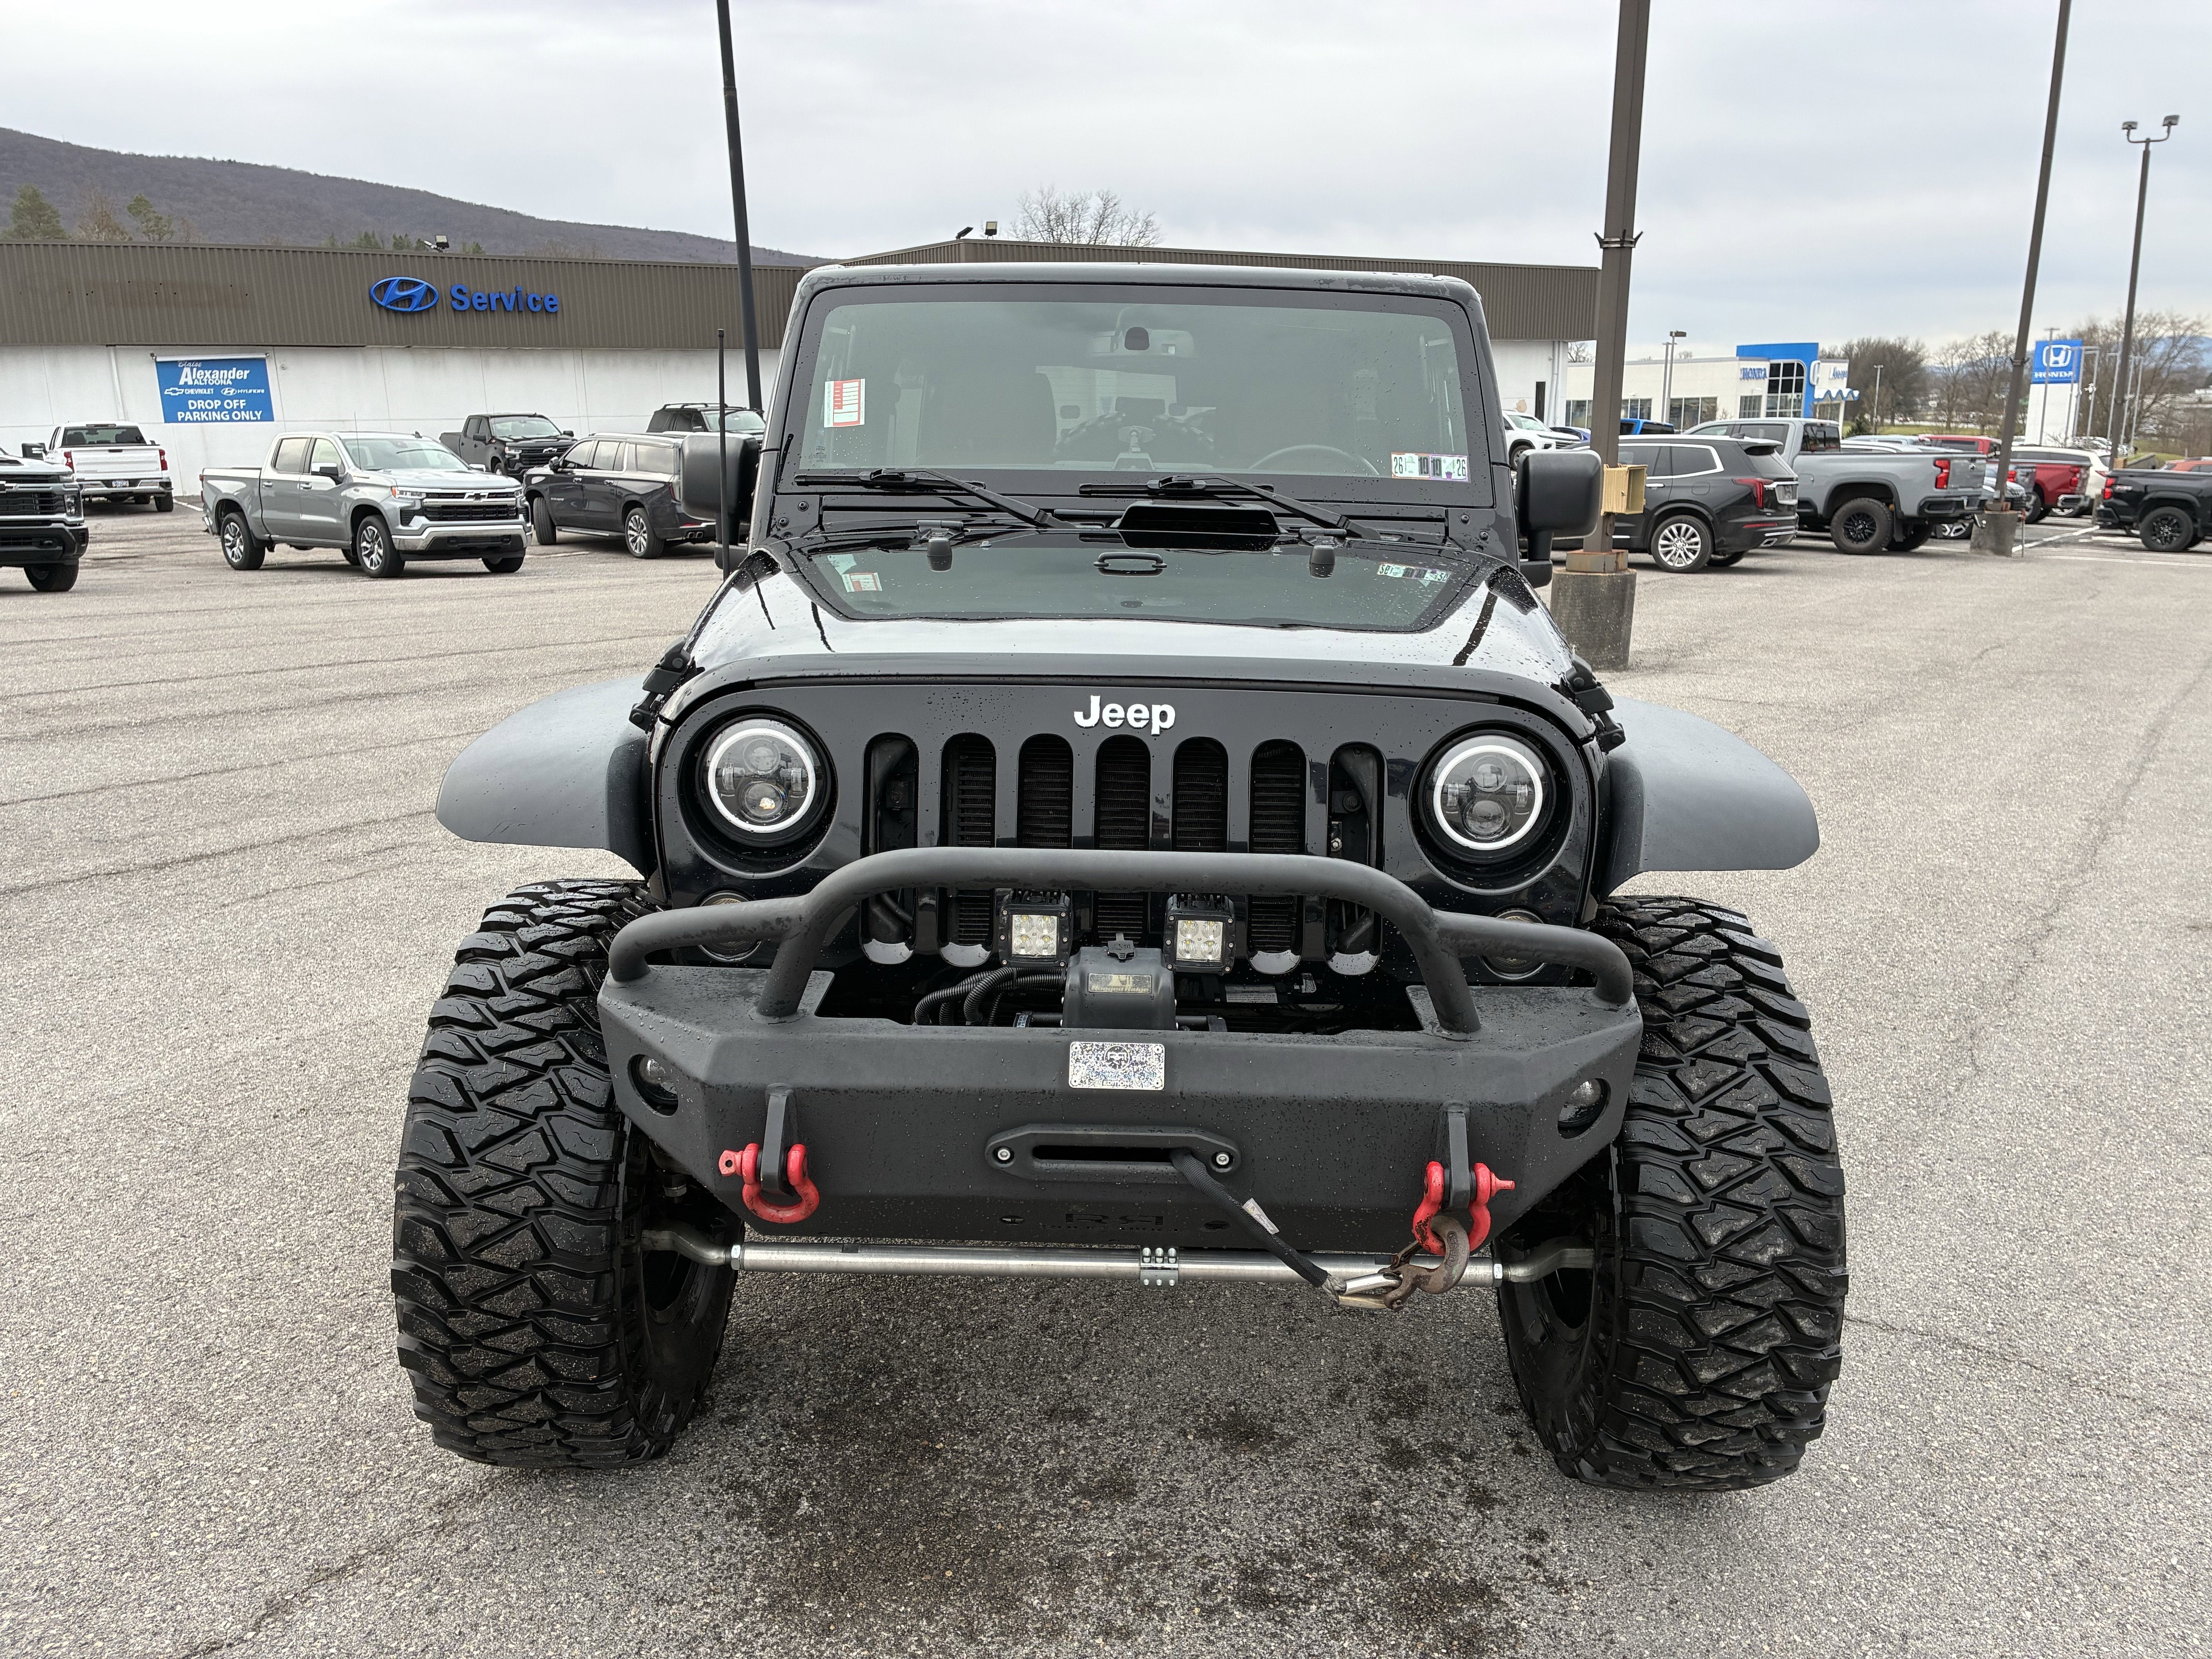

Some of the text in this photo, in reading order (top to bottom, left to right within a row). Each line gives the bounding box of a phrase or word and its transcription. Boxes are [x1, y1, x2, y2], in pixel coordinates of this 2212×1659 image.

[450, 283, 559, 313] Service
[179, 367, 250, 385] Alexander
[188, 399, 247, 410] DROP OFF
[177, 410, 263, 421] PARKING ONLY
[1394, 457, 1403, 474] 26
[1419, 457, 1429, 475] 10
[1456, 459, 1466, 477] 26
[1073, 695, 1175, 737] Jeep
